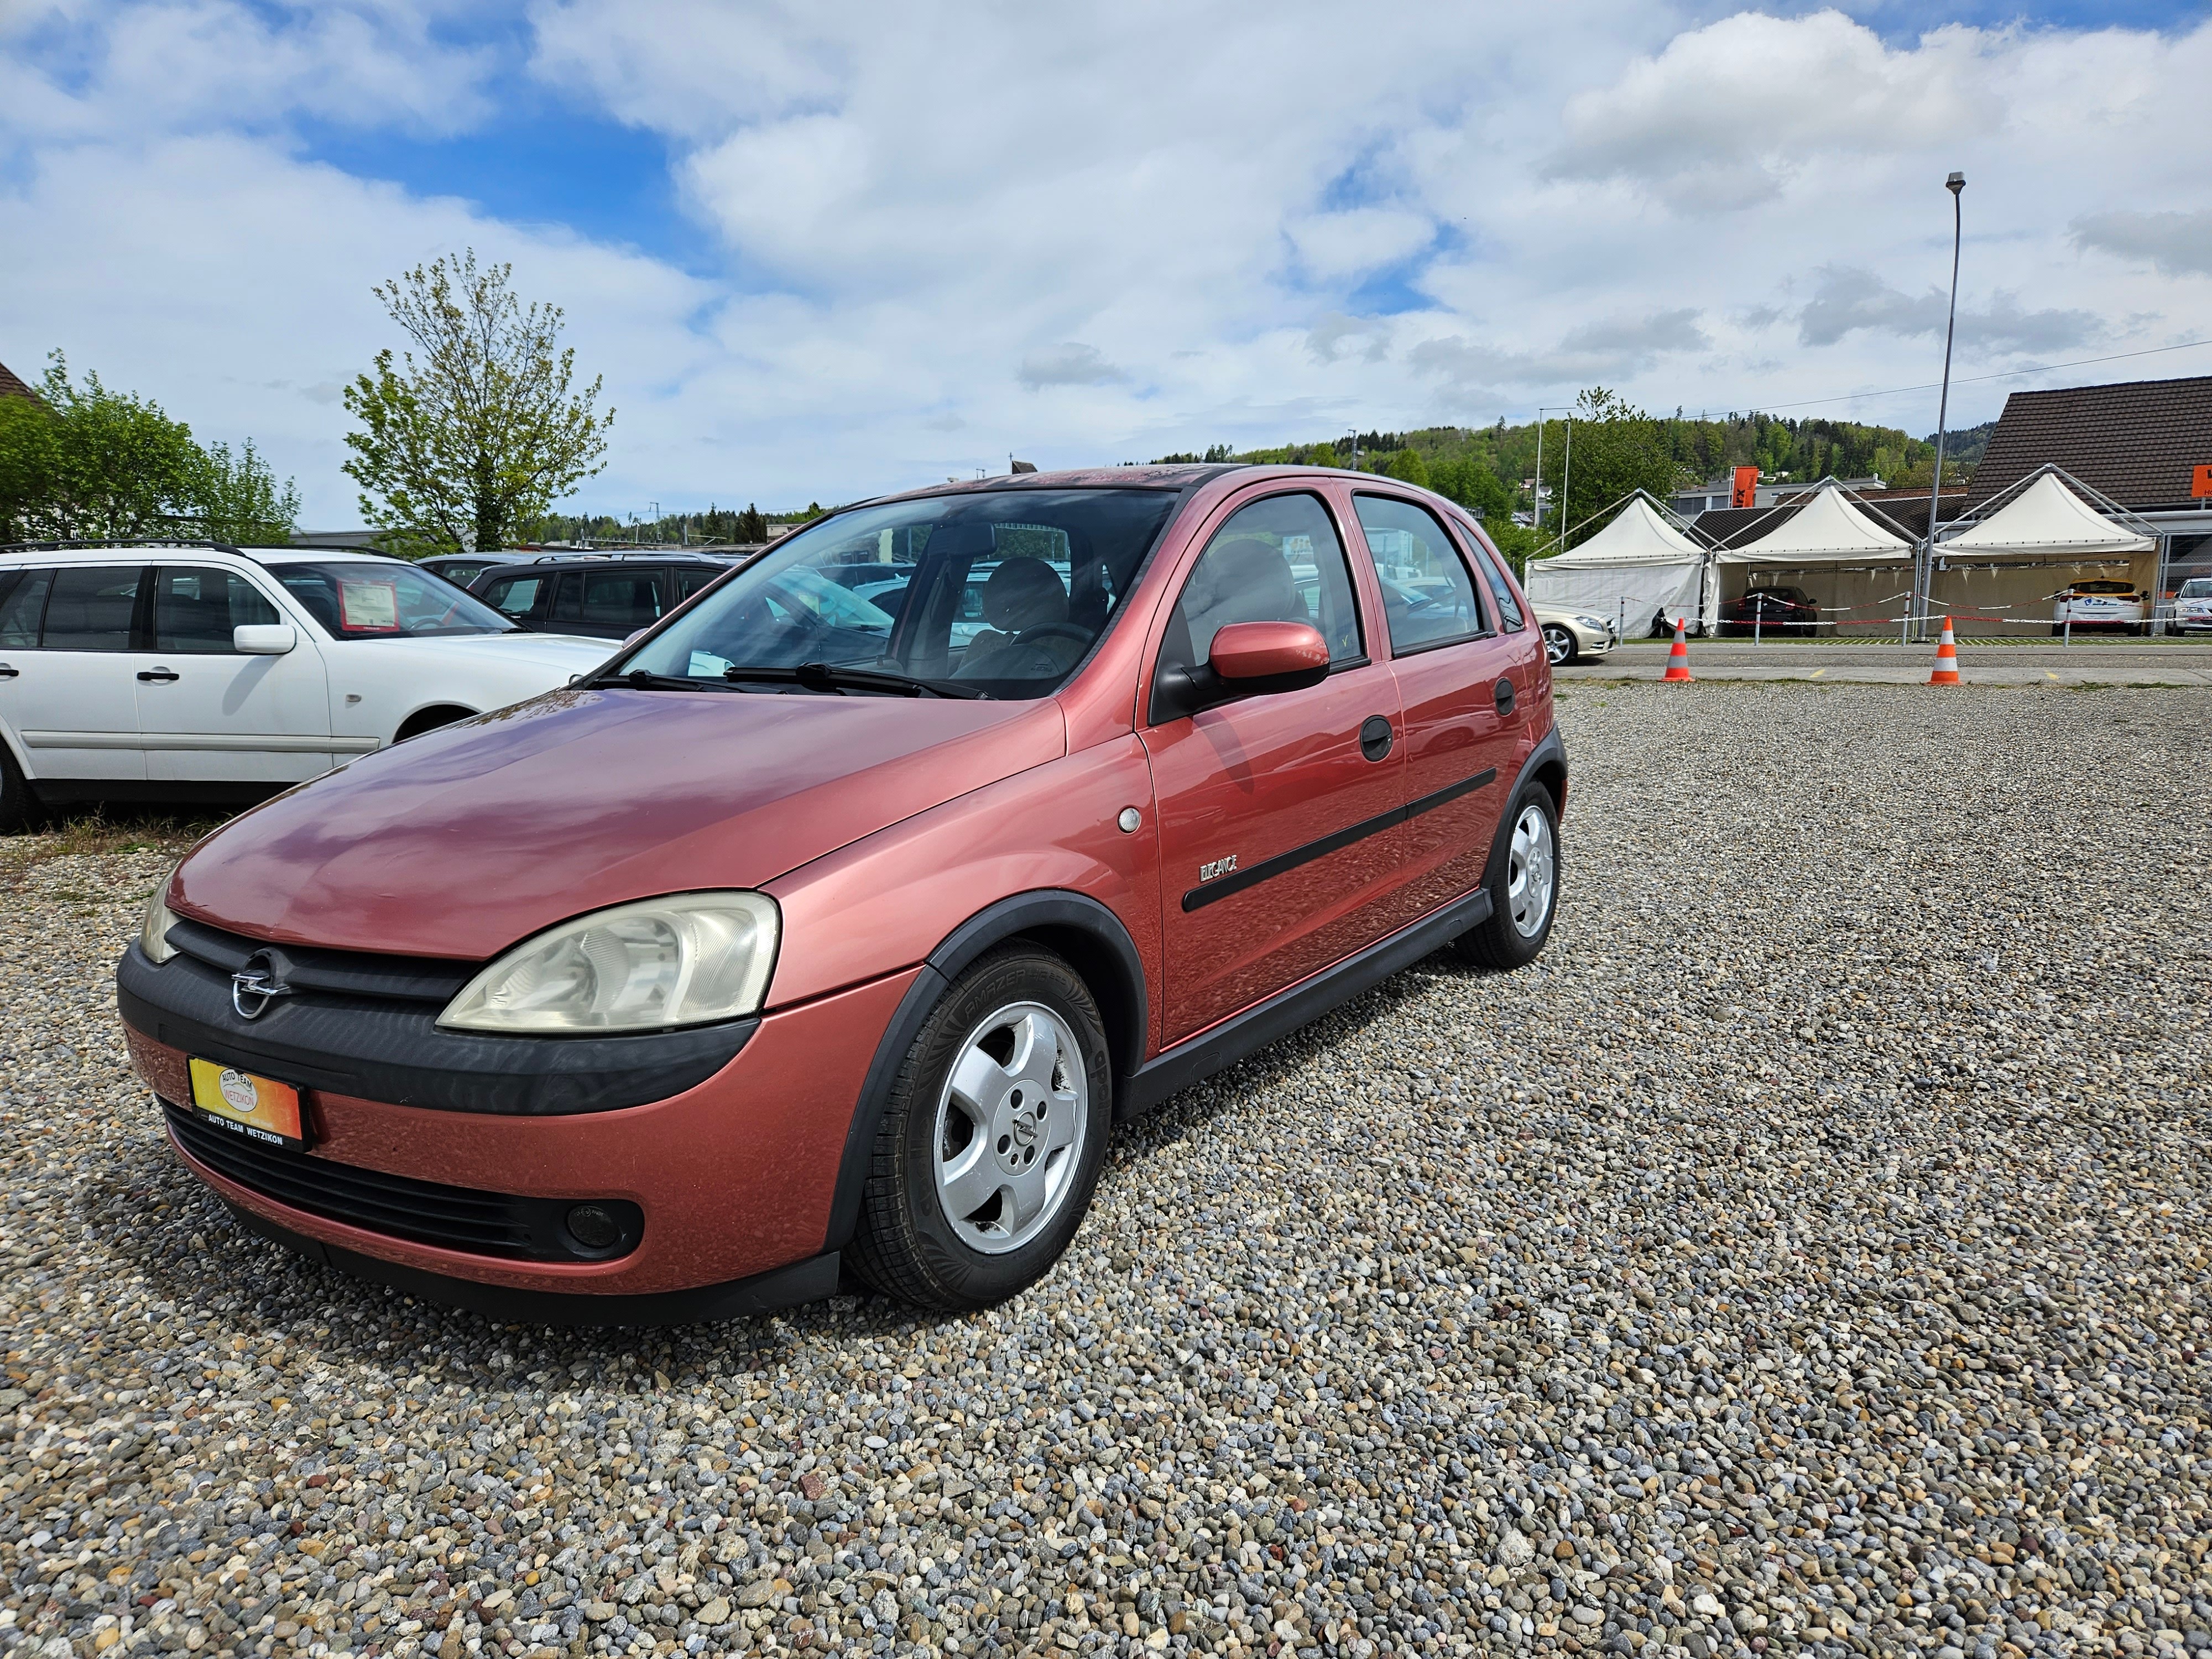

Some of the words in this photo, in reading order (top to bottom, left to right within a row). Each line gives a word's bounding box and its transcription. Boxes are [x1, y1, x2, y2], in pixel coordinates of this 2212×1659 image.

[1746, 474, 1755, 490] Hinwil
[1199, 854, 1237, 882] ELEGANCE
[965, 968, 1026, 1020] AMAZER
[222, 1072, 235, 1083] AUTO
[238, 1074, 252, 1091] TEAM
[223, 1089, 254, 1107] WETZIKON
[208, 1114, 224, 1126] AUTO
[226, 1120, 244, 1133] TEAM
[246, 1126, 283, 1145] WETZIKON
